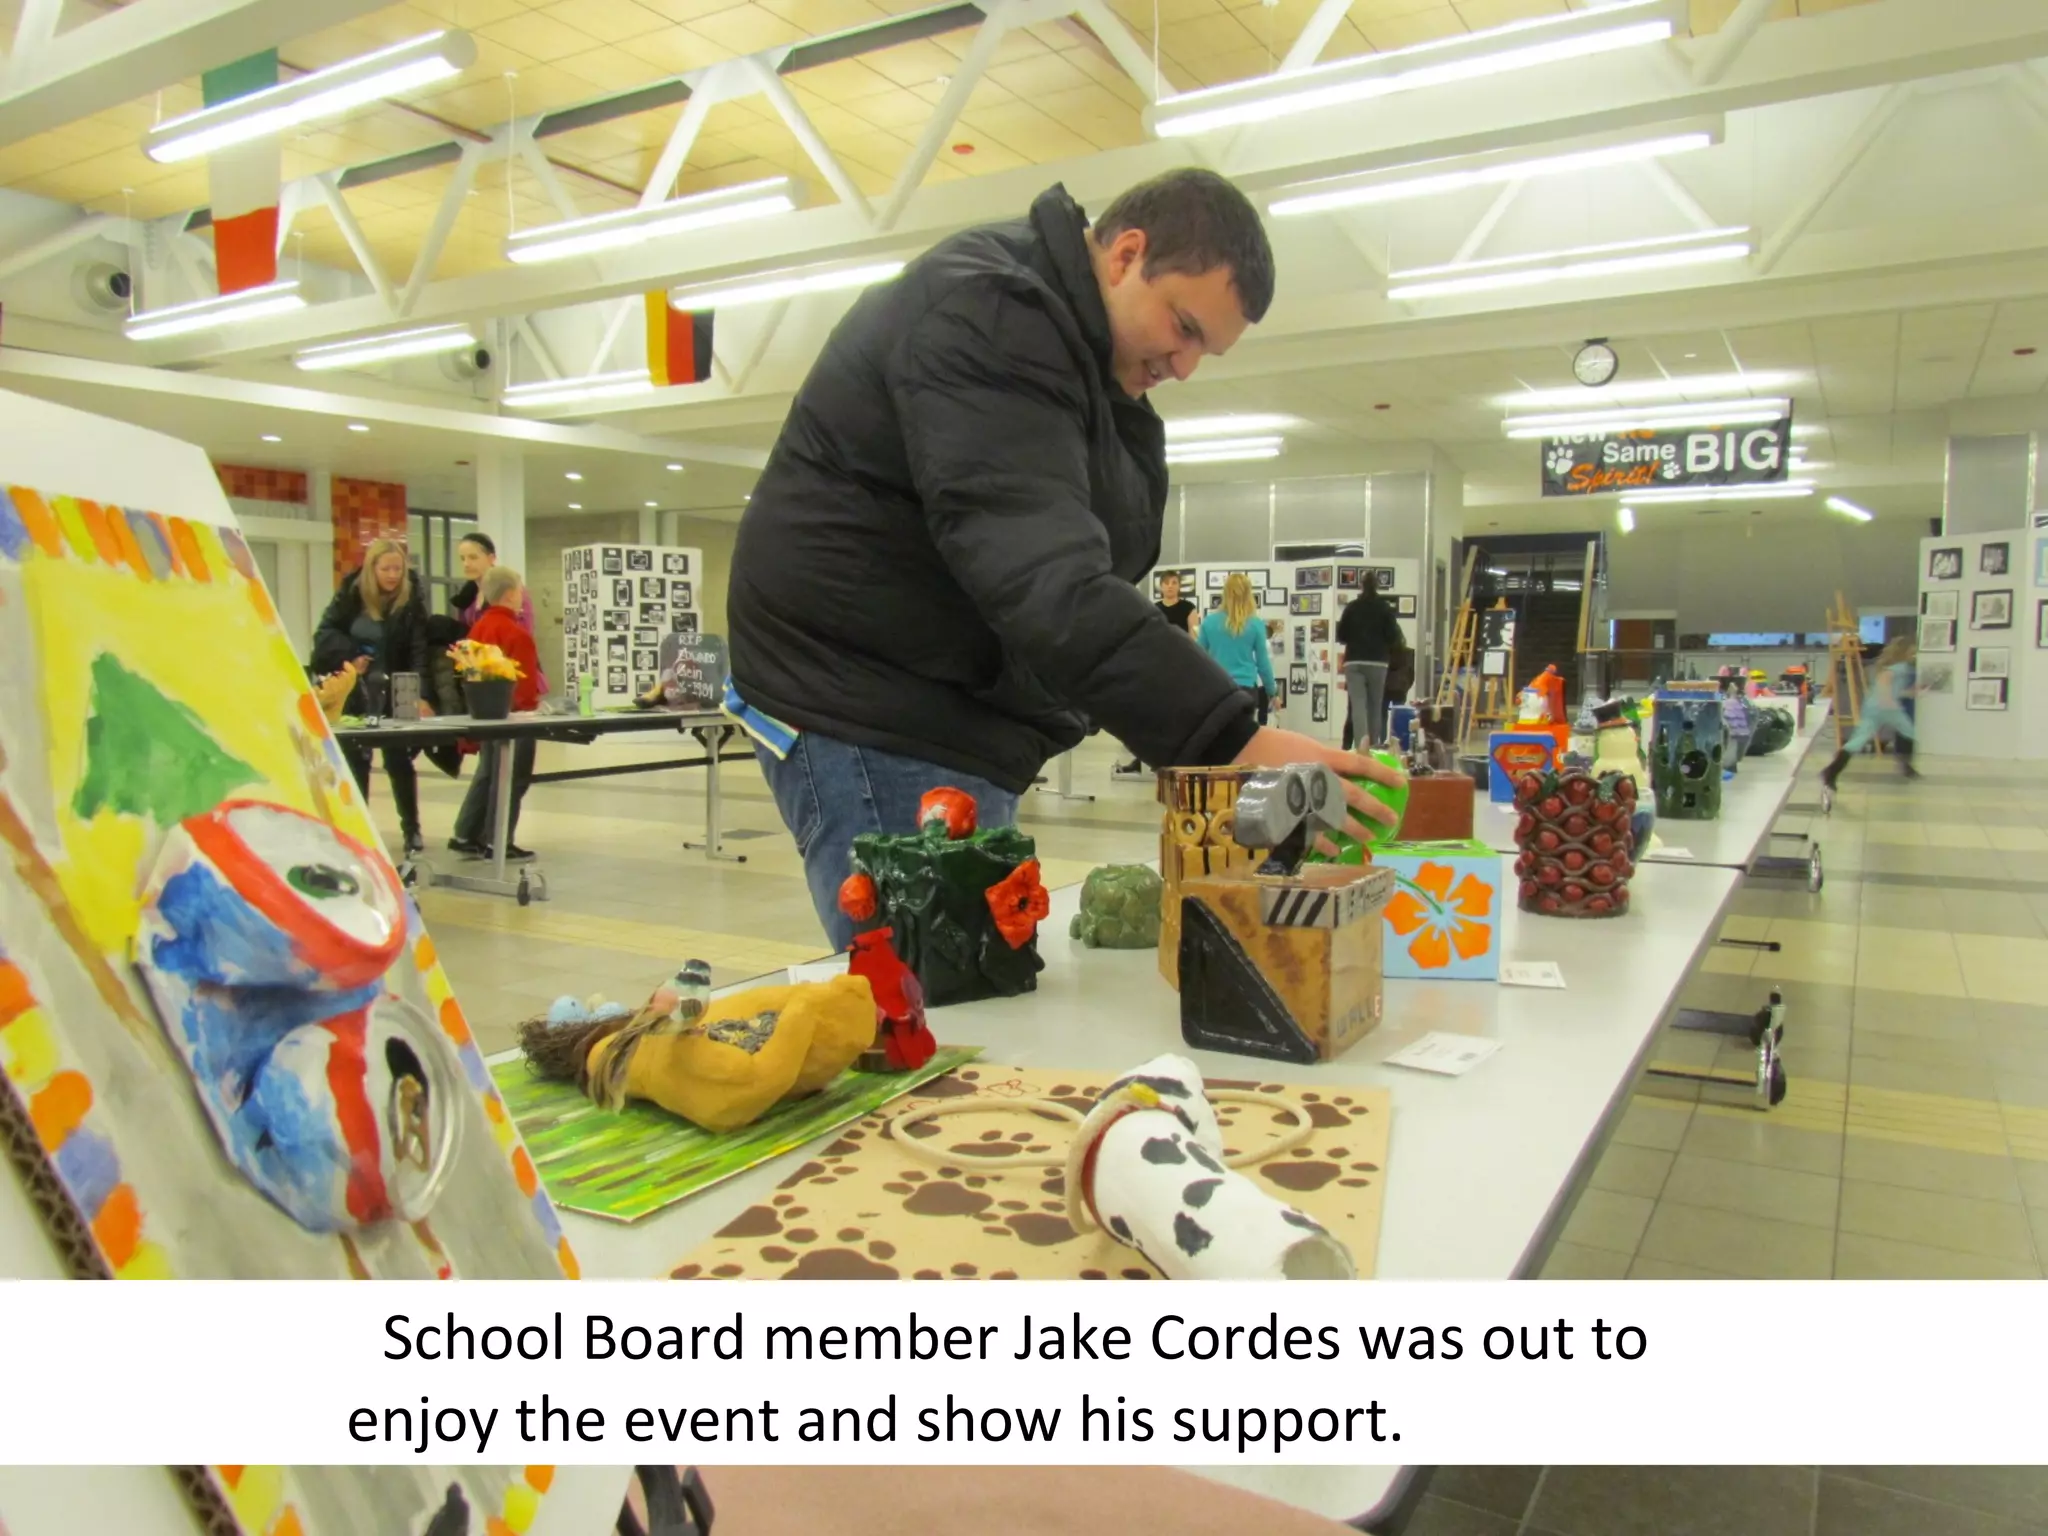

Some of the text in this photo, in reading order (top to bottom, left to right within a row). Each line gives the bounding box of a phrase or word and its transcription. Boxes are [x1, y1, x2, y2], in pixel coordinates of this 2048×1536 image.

[1603, 443, 1676, 463] Same
[1686, 429, 1779, 473] BIG
[1567, 461, 1660, 494] Spirit!
